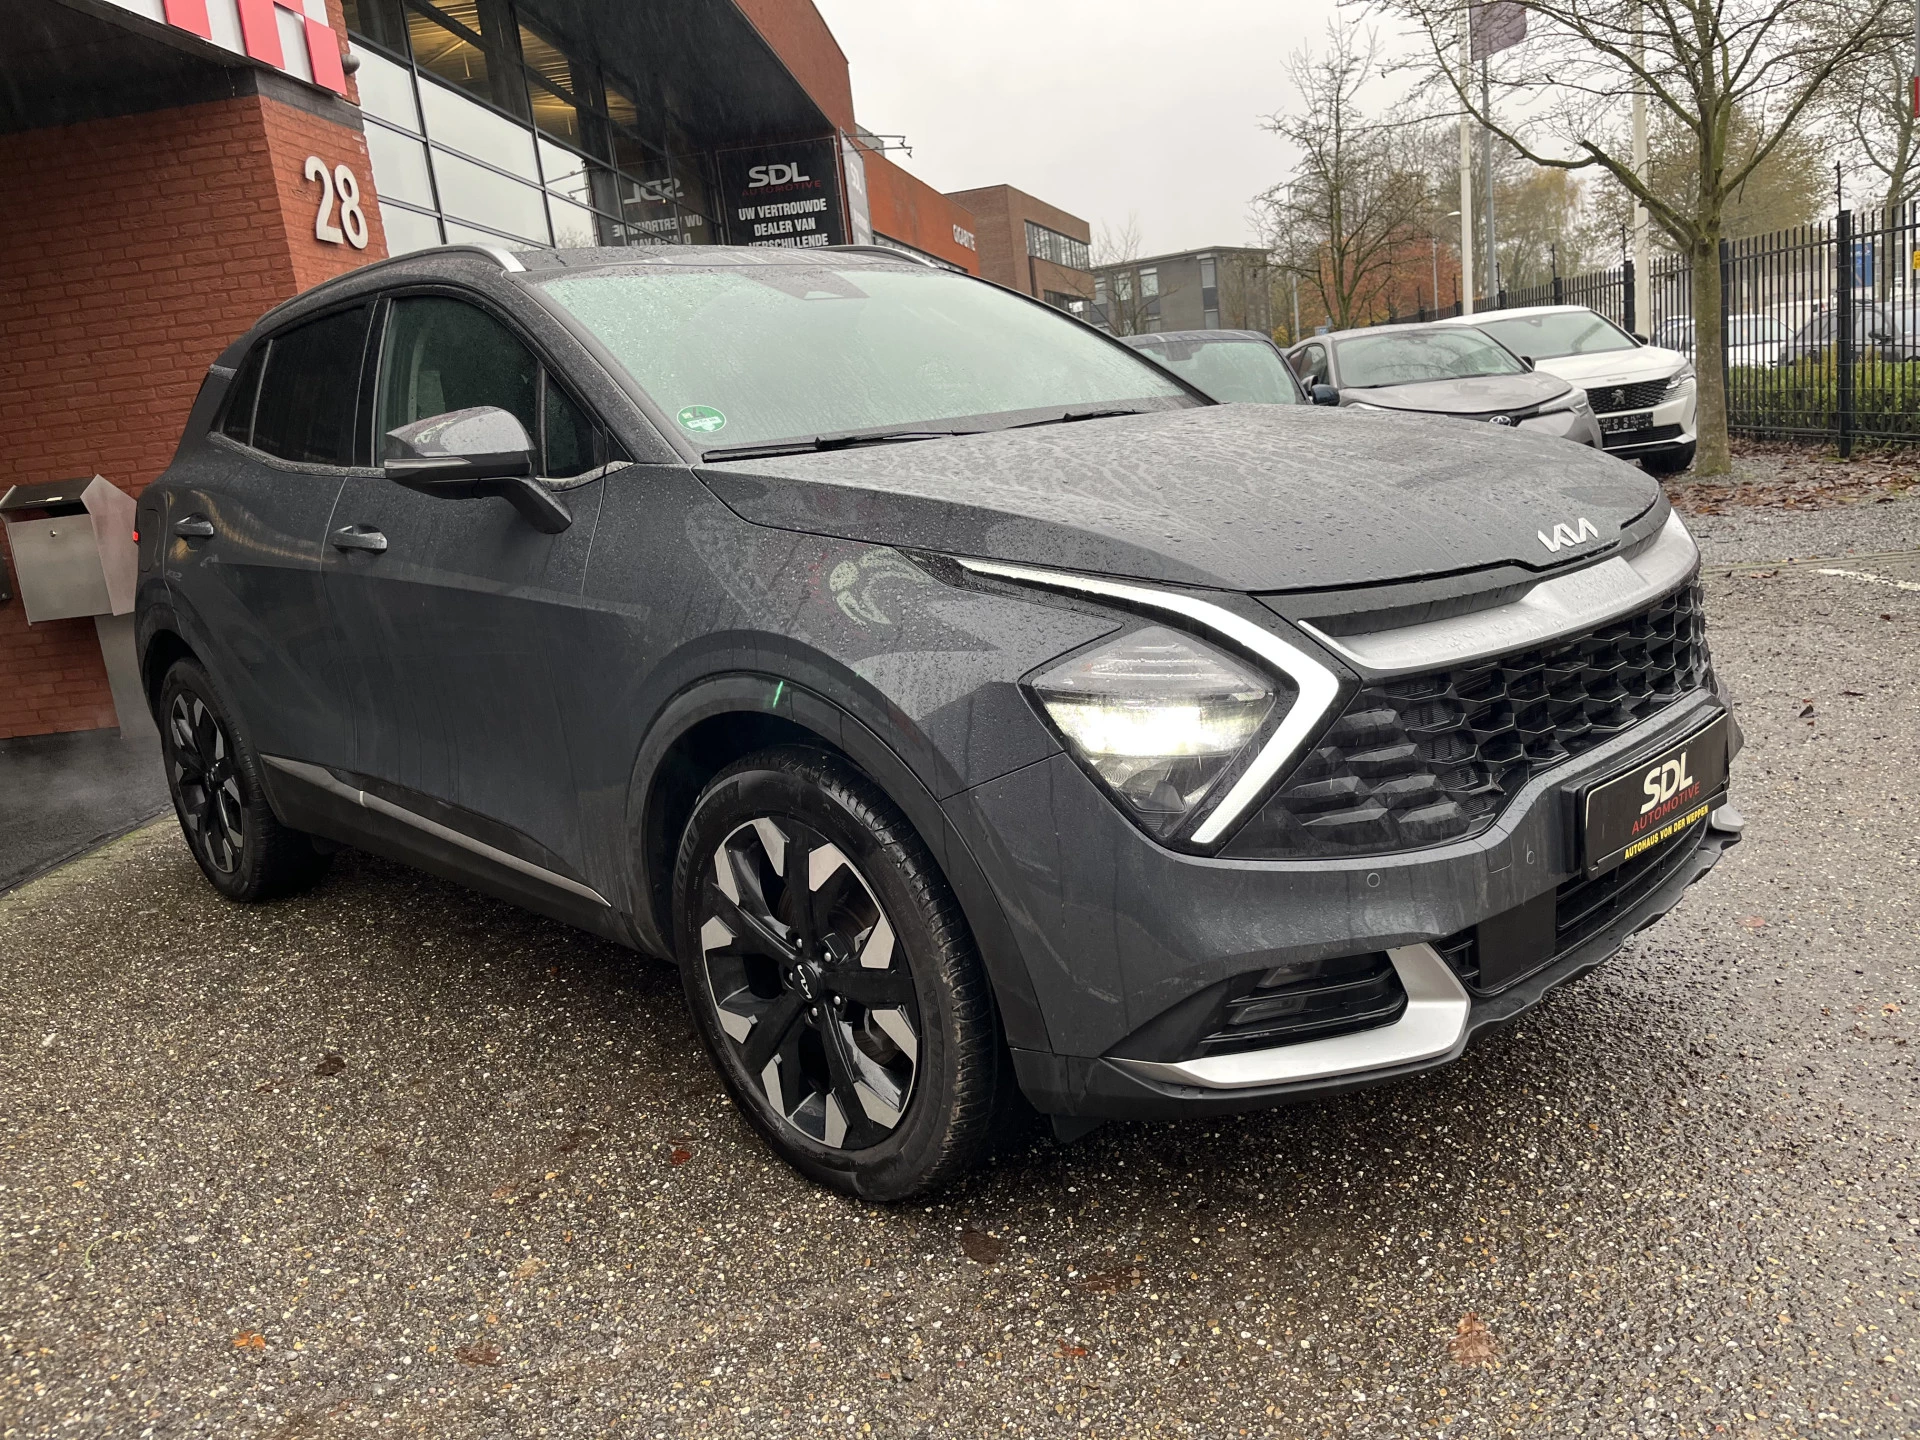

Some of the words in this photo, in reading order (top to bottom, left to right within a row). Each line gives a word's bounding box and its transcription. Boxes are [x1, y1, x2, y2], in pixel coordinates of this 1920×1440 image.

[742, 179, 822, 196] AUTOMOTIVE
[748, 162, 810, 188] SDL
[305, 155, 369, 249] 28
[738, 206, 756, 221] UW
[757, 198, 828, 219] VERTROUWDE
[753, 220, 794, 237] DEALER
[794, 217, 816, 232] VAN
[1537, 517, 1598, 552] KIA
[1639, 751, 1693, 815] SDL
[1631, 781, 1700, 836] AUTOMOTIVE
[1624, 834, 1659, 860] AUTOHAUS
[1660, 827, 1673, 841] VON
[1673, 820, 1686, 833] DER
[1686, 804, 1709, 826] WEPPEN
